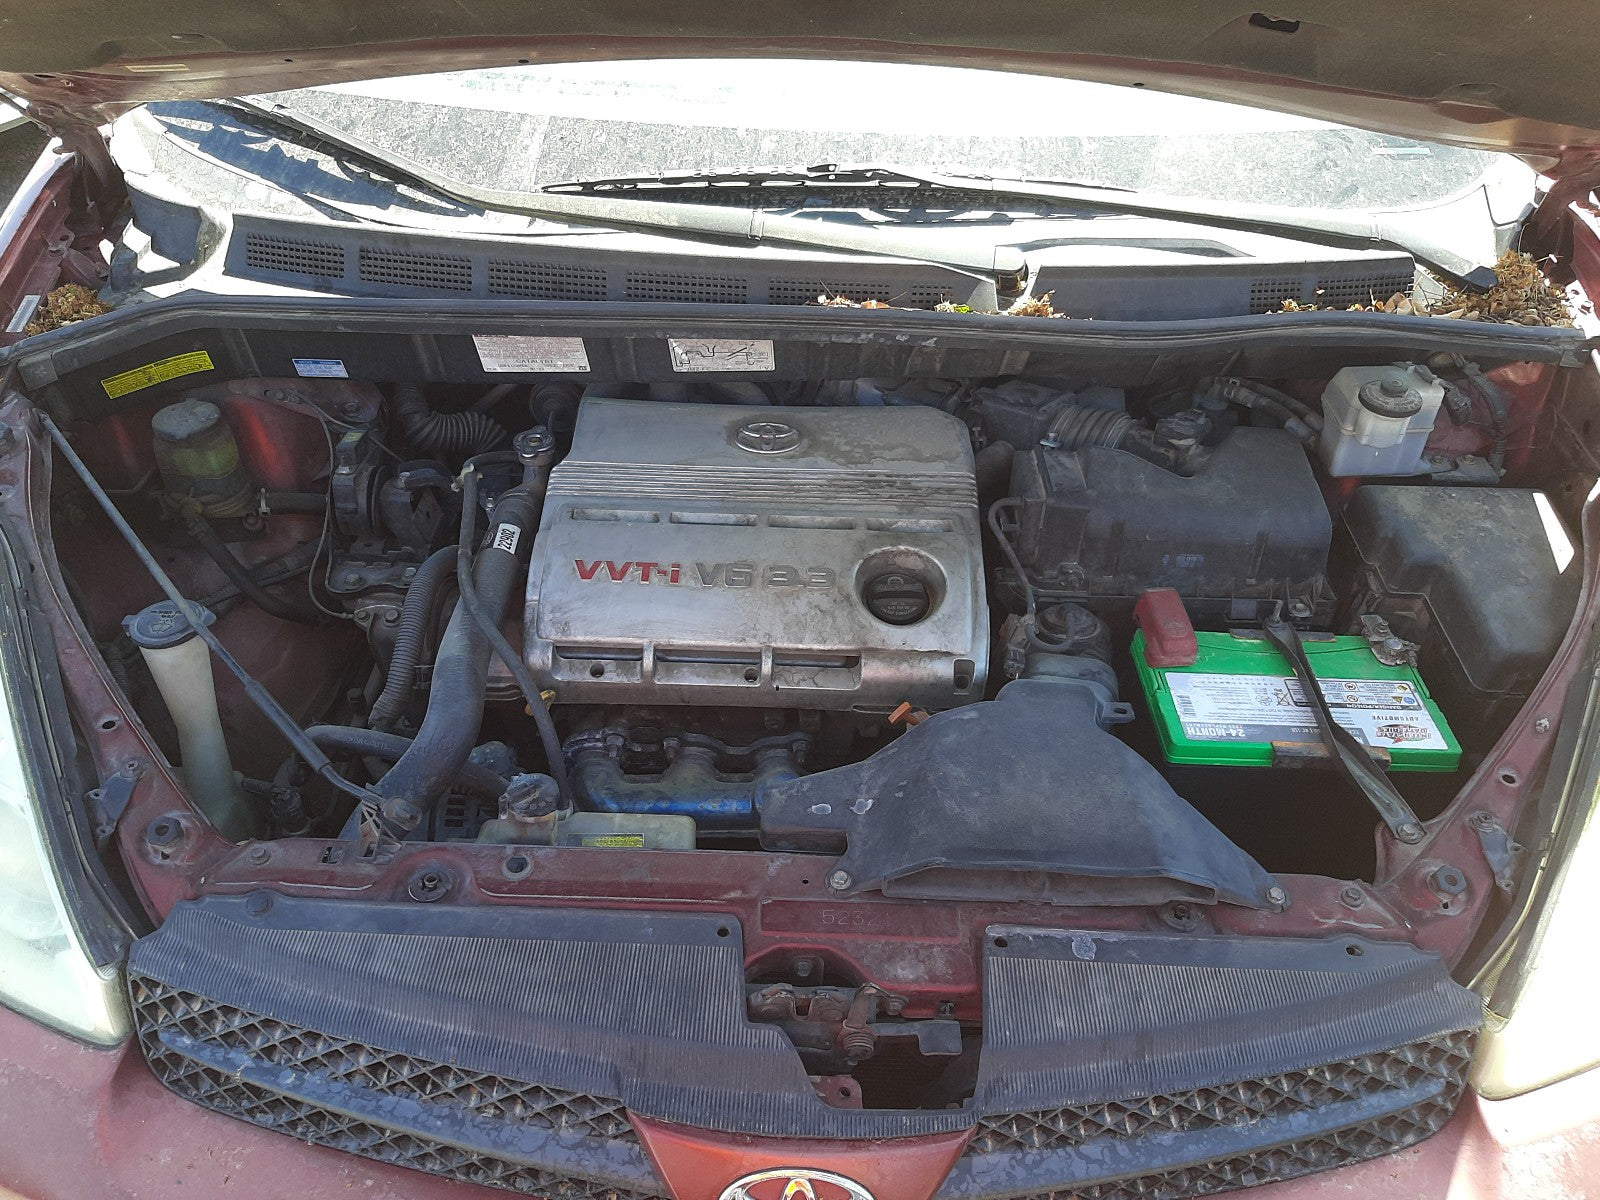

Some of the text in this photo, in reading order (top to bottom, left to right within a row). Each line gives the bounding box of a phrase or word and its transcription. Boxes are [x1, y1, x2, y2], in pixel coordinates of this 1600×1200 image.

[574, 559, 681, 585] VVT-i
[695, 560, 751, 588] V6
[1186, 727, 1246, 738] 24-MONTH
